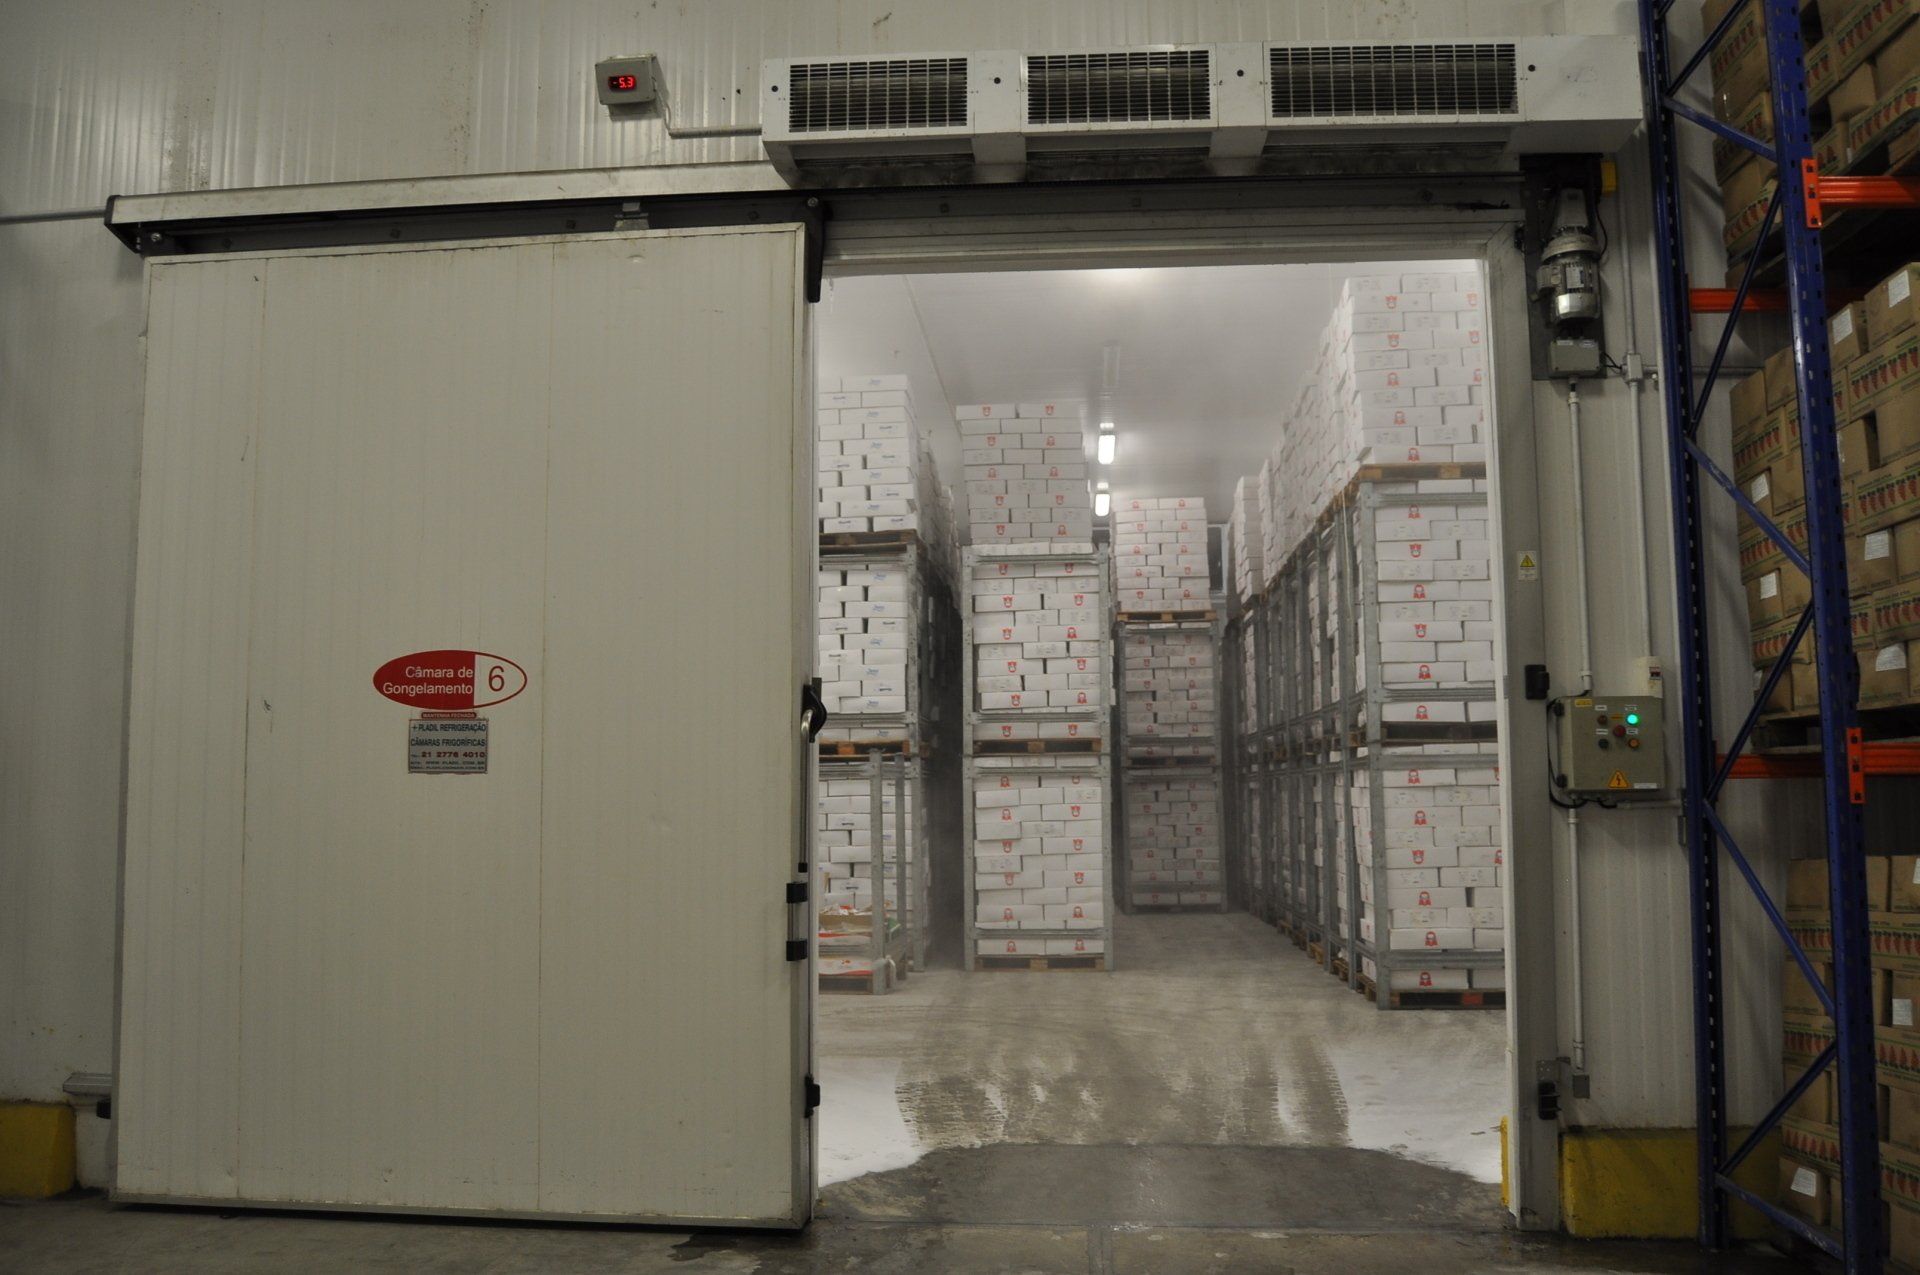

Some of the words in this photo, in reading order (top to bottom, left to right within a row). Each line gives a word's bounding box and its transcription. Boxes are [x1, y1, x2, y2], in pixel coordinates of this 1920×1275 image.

[405, 666, 454, 678] Câmara
[457, 666, 474, 678] de
[488, 665, 506, 692] 6
[439, 722, 486, 734] REFRIGERAÇÃO
[410, 737, 440, 747] CÂMARAS
